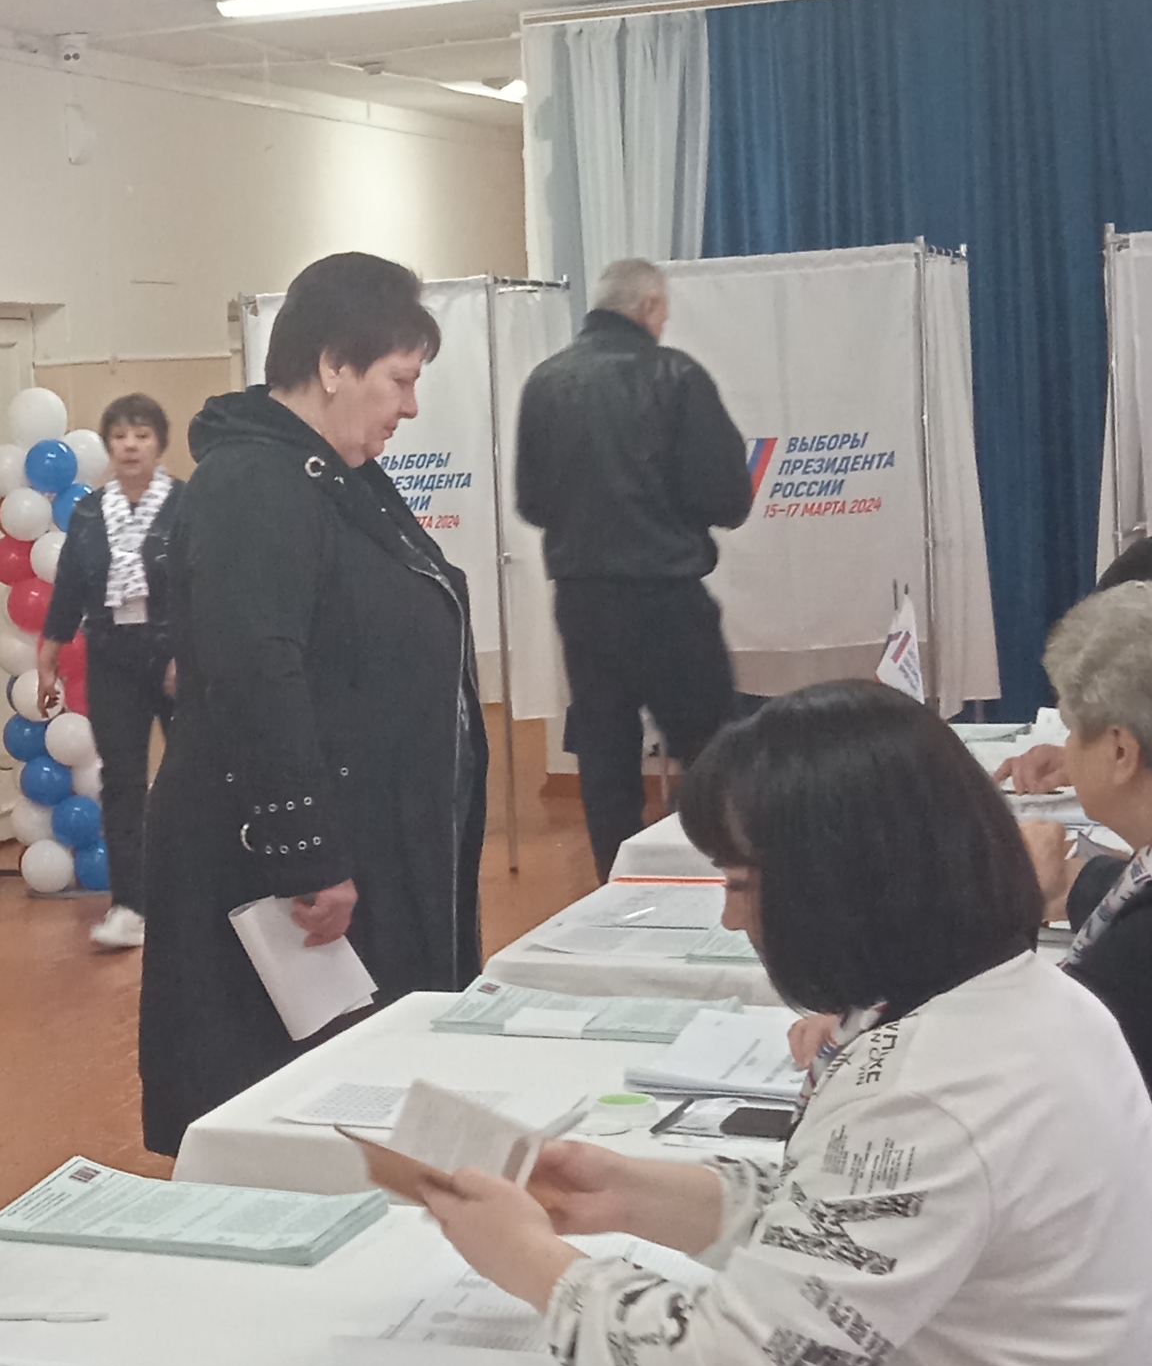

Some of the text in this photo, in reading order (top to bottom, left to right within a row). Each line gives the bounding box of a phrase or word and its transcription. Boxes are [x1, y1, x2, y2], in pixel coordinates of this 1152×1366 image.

[786, 432, 869, 454] ВЫБОРЫ
[381, 452, 451, 471] ВЫБОРЫ
[778, 450, 896, 476] ПРЕЗИДЕНТА
[394, 472, 472, 492] ЕЗИДЕНТА
[769, 479, 845, 499] РОССИИ
[801, 500, 847, 517] МАРТА
[848, 497, 882, 514] 2024
[434, 515, 461, 529] 2024
